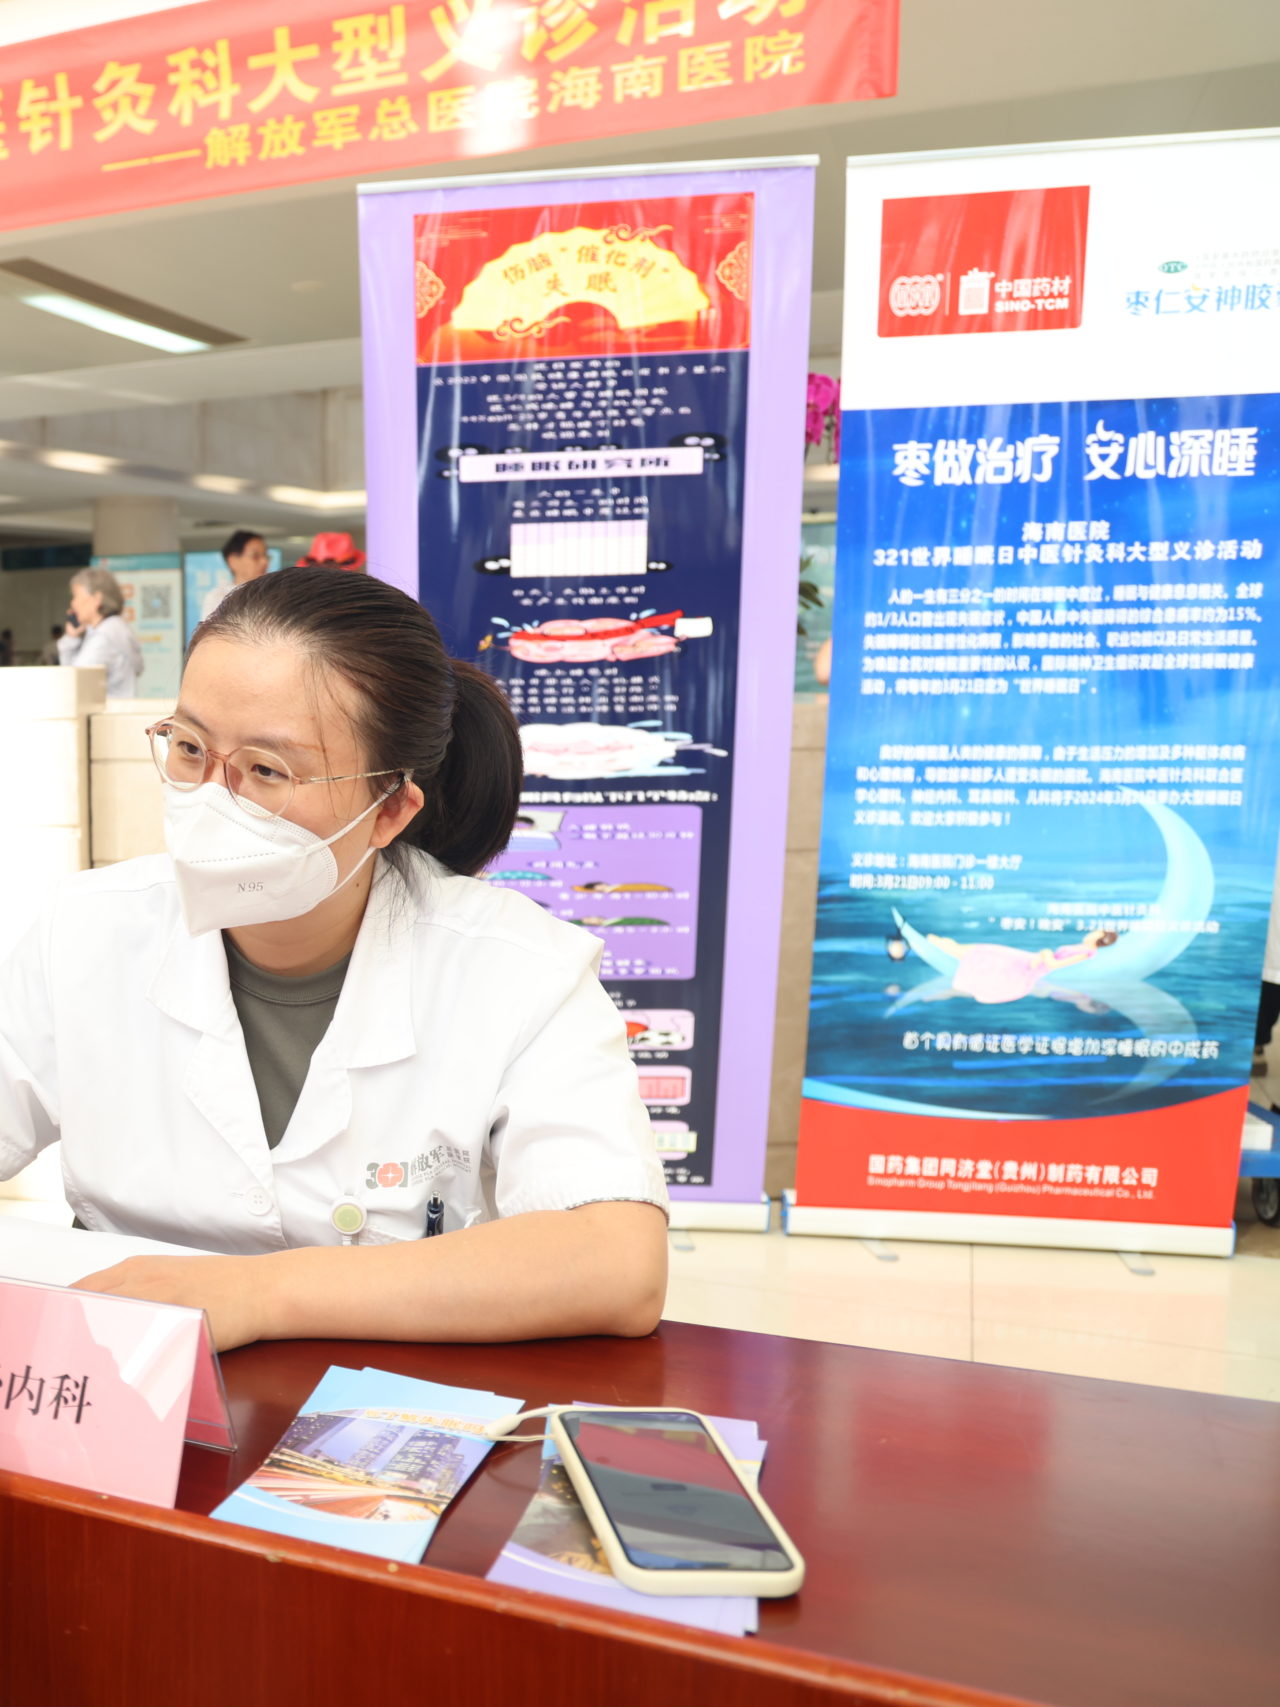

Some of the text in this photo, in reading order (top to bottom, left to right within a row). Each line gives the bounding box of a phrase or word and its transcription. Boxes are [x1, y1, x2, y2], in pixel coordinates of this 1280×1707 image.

[994, 275, 1072, 298] 中国药材
[994, 298, 1070, 314] SINO-TCM
[1125, 283, 1280, 316] 枣仁安神胶
[892, 419, 1259, 487] 枣做治疗 安心深睡
[1021, 521, 1111, 542] 海南医院
[237, 881, 264, 893] N95
